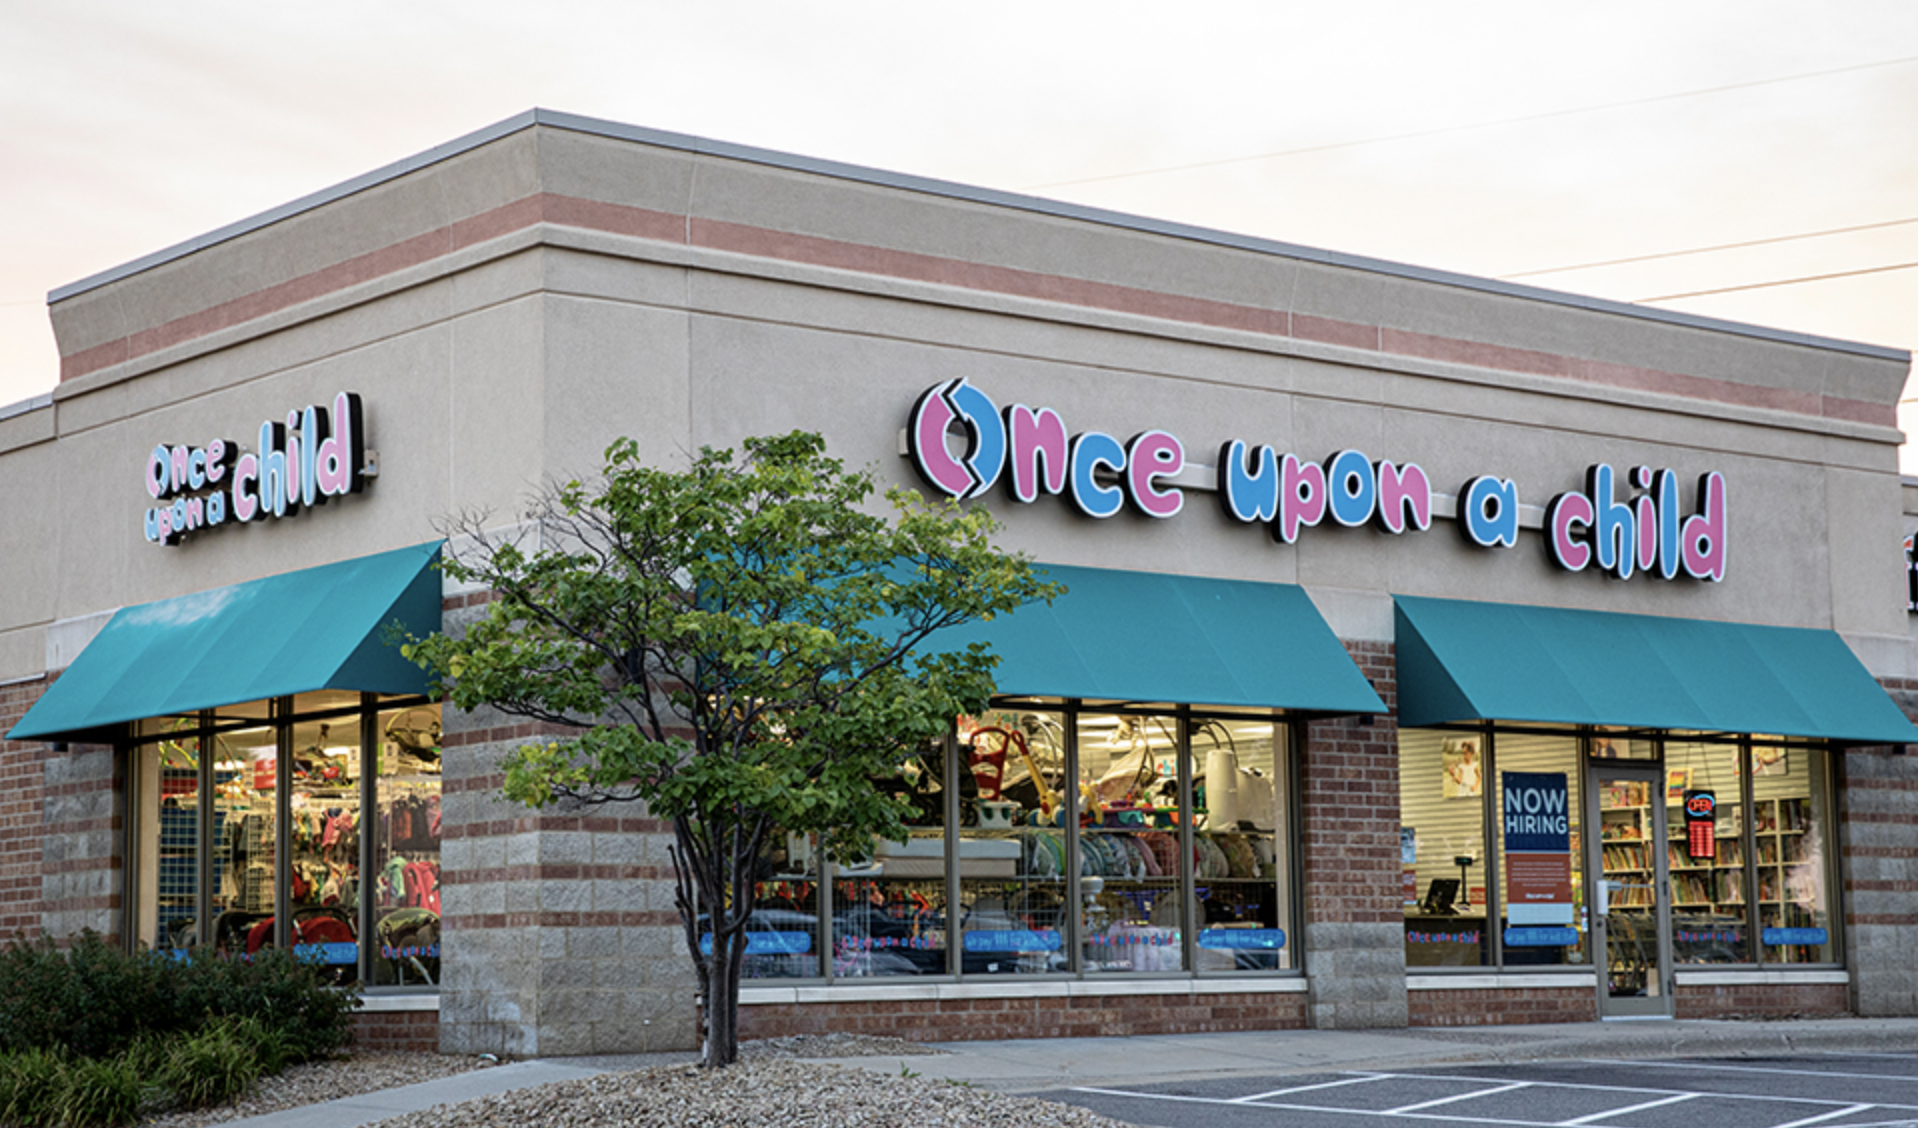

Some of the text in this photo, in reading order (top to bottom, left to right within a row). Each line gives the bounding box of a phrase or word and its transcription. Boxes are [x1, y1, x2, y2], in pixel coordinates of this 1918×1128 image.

[145, 438, 226, 499] Once
[232, 391, 351, 522] child
[912, 376, 1728, 582] Once upon a child
[144, 490, 226, 546] upon a
[1505, 787, 1566, 814] NOW
[1506, 815, 1568, 835] HIRING
[1687, 798, 1713, 812] OPEN
